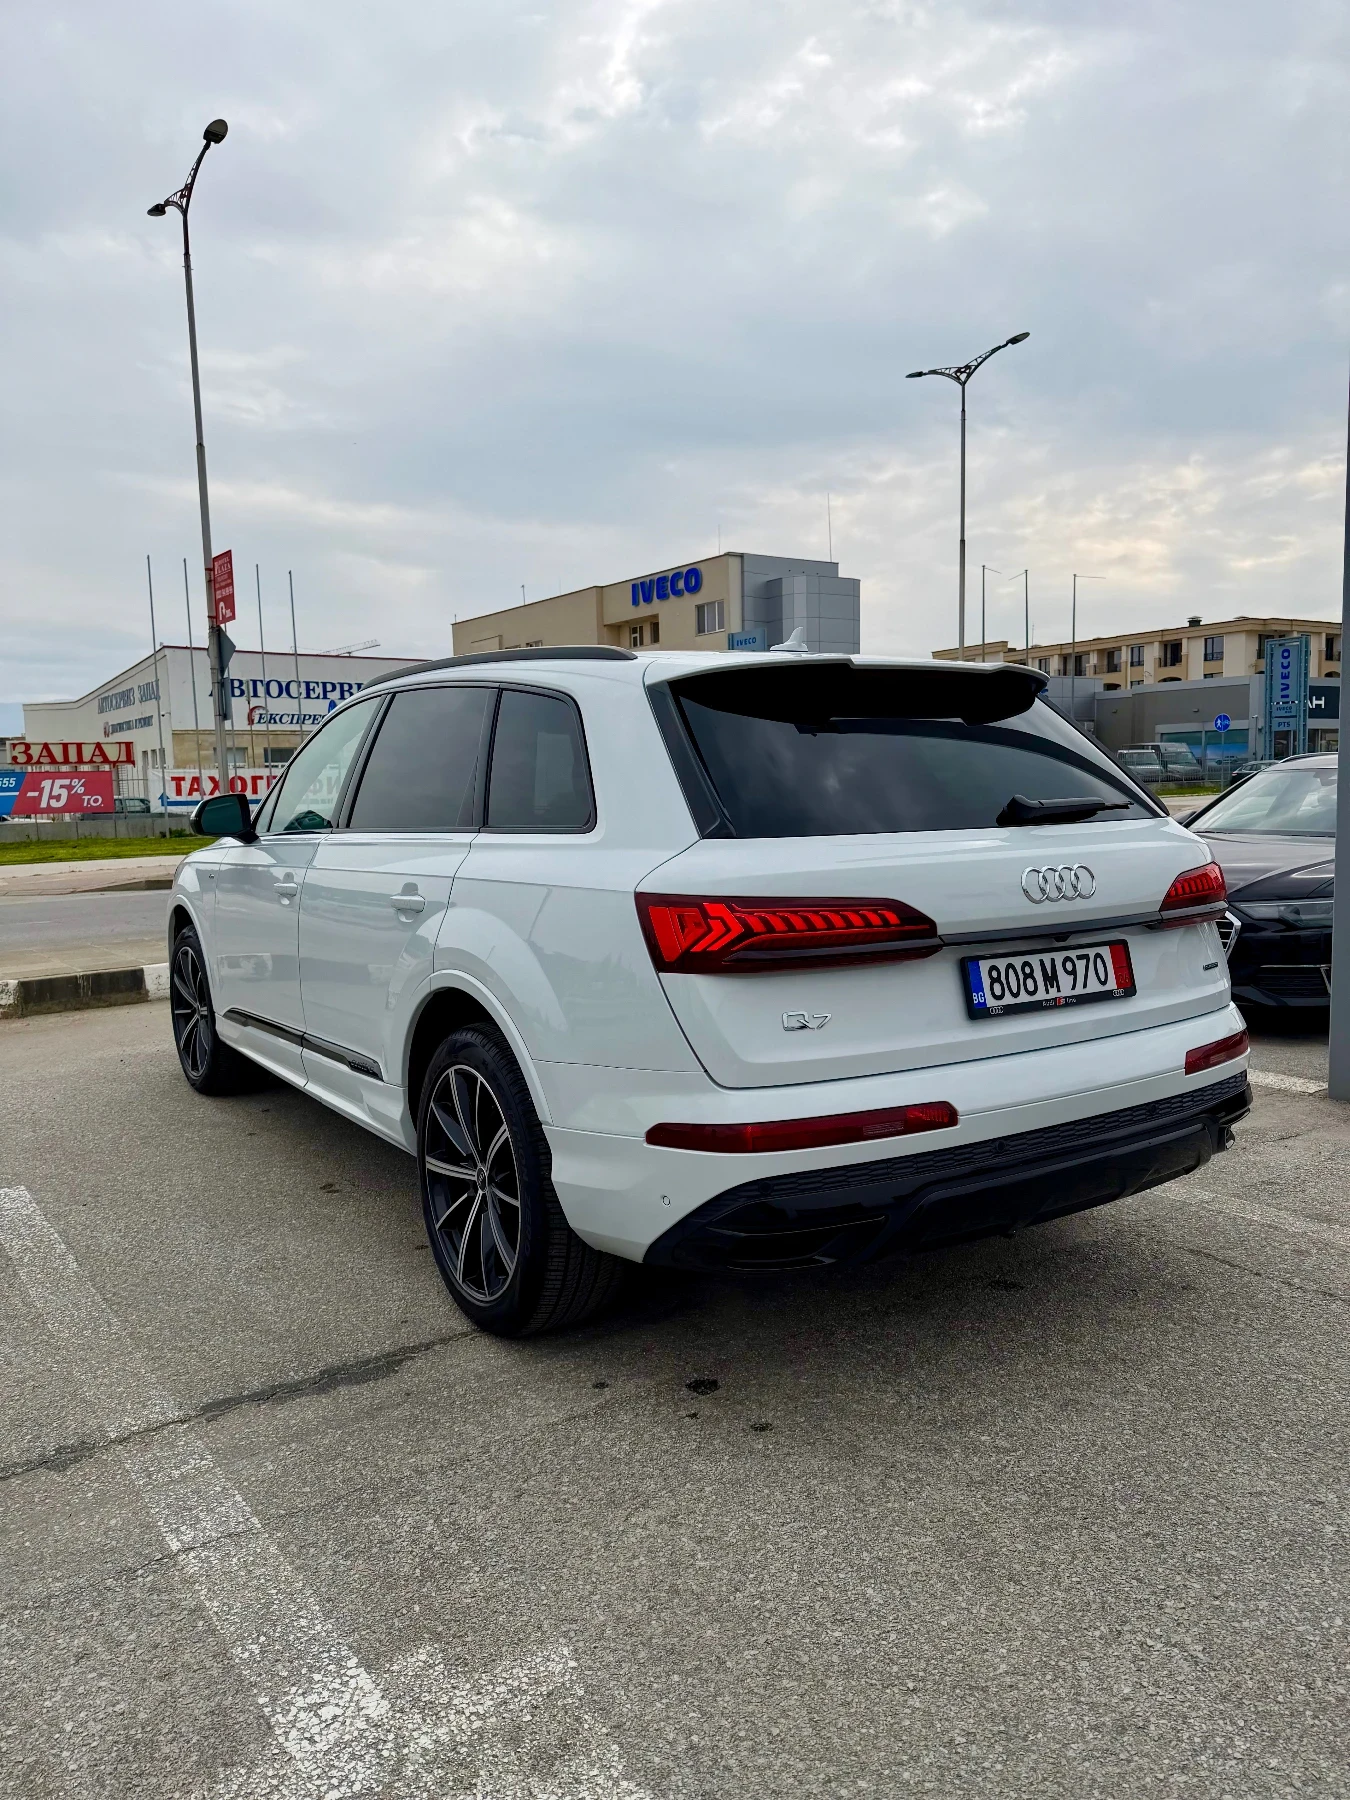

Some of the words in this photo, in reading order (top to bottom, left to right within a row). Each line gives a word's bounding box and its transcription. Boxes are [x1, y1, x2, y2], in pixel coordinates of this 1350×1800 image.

[632, 567, 703, 607] IVECO
[736, 637, 757, 647] IVECO
[1281, 648, 1291, 699] IVECO
[257, 713, 327, 725] ЕКСПРЕ
[11, 742, 135, 768] ЗАПАД
[27, 778, 85, 809] -15%
[972, 992, 985, 1004] BG
[782, 1011, 832, 1031] Q7
